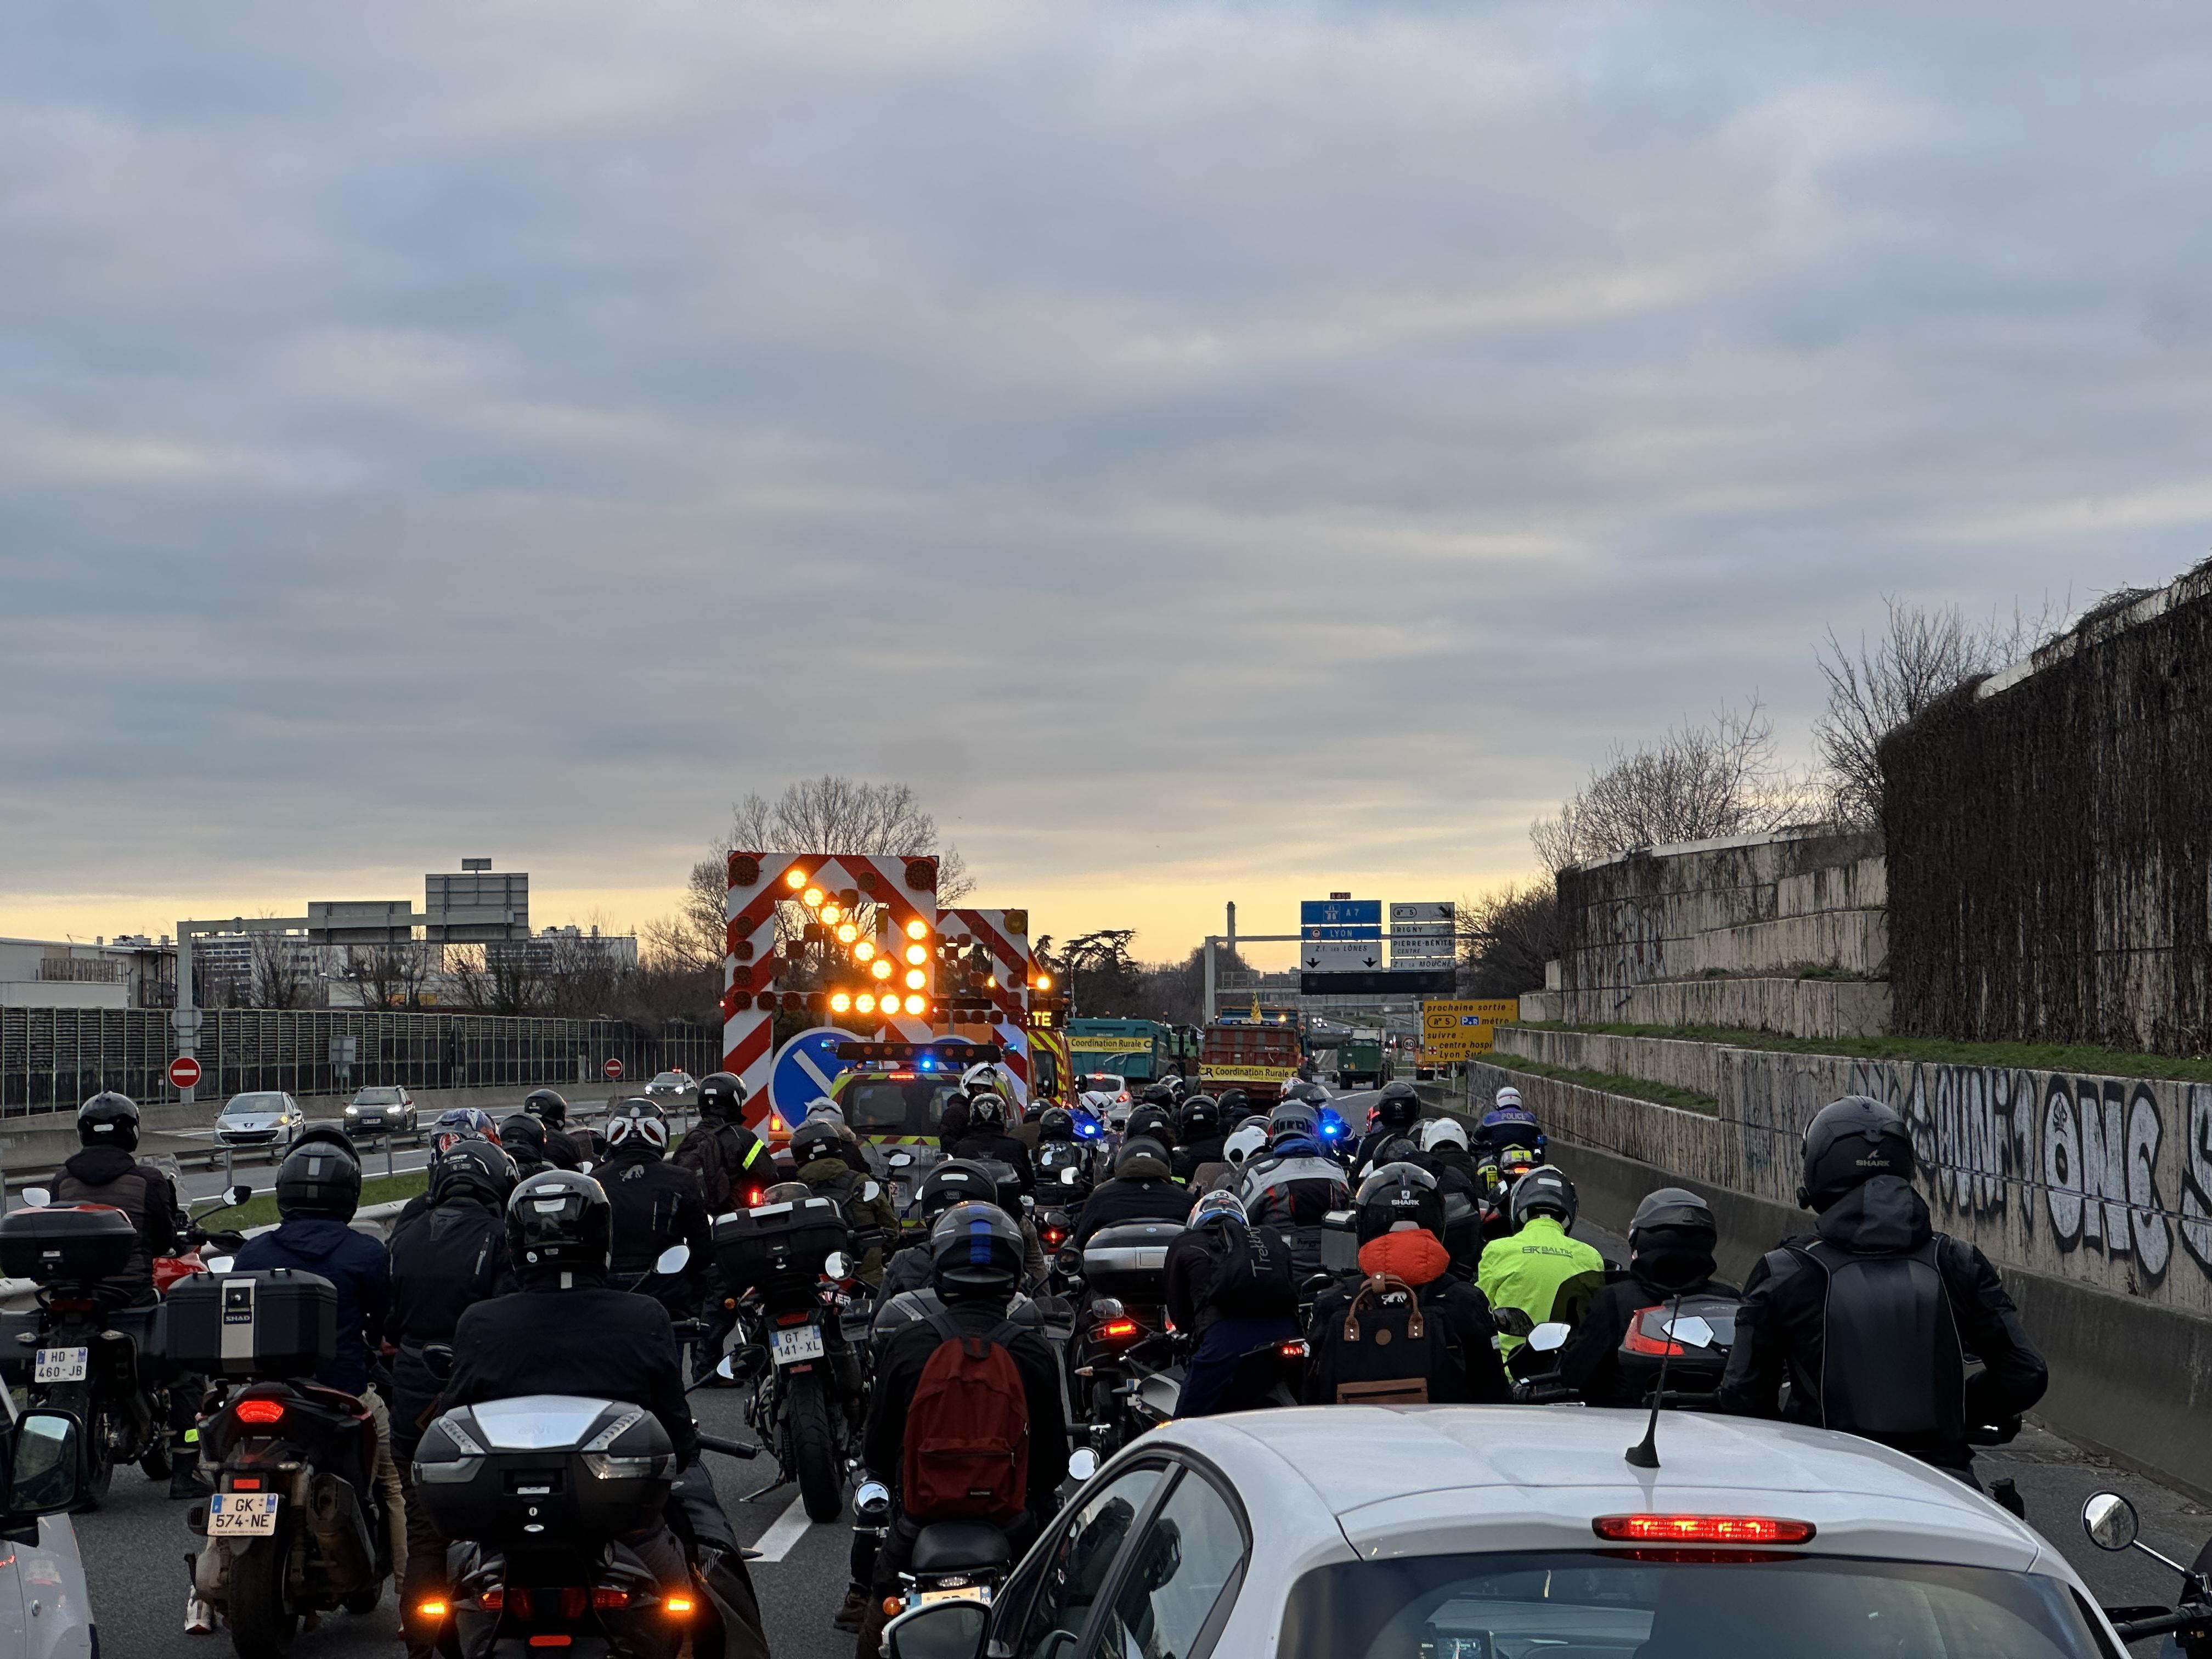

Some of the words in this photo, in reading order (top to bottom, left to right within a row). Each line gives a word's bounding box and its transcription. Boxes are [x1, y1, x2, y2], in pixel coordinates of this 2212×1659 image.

[1330, 929, 1352, 938] LYON
[1427, 1003, 1473, 1012] prochaine
[1071, 1039, 1117, 1047] Coordination
[1119, 1039, 1141, 1047] Rurale
[1440, 1051, 1460, 1059] Lyon
[1215, 1067, 1263, 1076] Coordination
[1265, 1068, 1288, 1077] Rurale
[1243, 1224, 1273, 1278] Trekking
